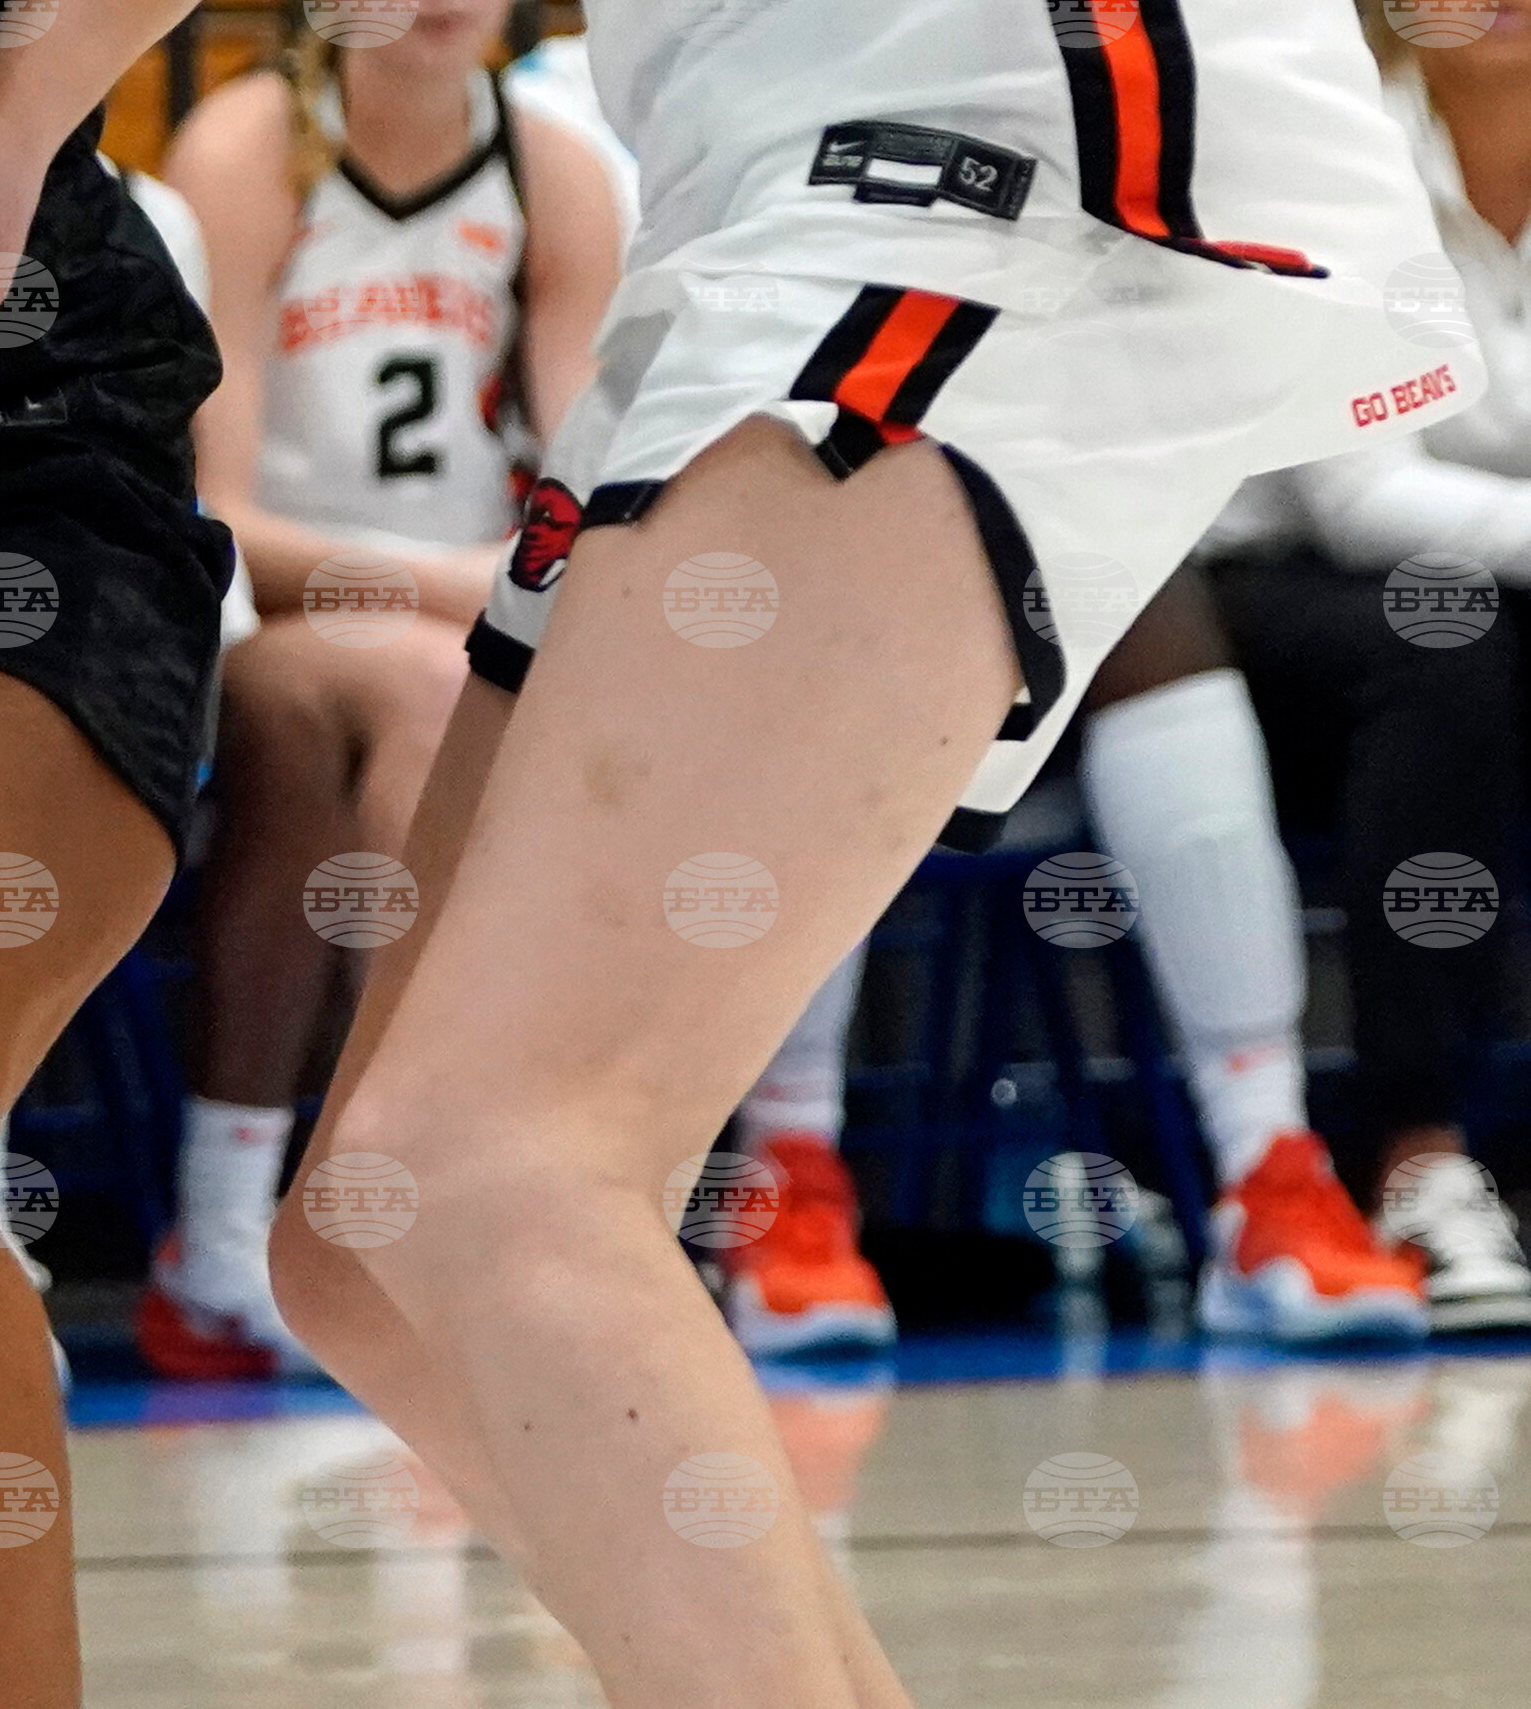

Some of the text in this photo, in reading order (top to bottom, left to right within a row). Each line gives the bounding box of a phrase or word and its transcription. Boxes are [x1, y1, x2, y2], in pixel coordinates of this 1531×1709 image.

[959, 155, 998, 192] 52
[376, 356, 440, 476] 2
[1351, 363, 1456, 427] GO BEAVS
